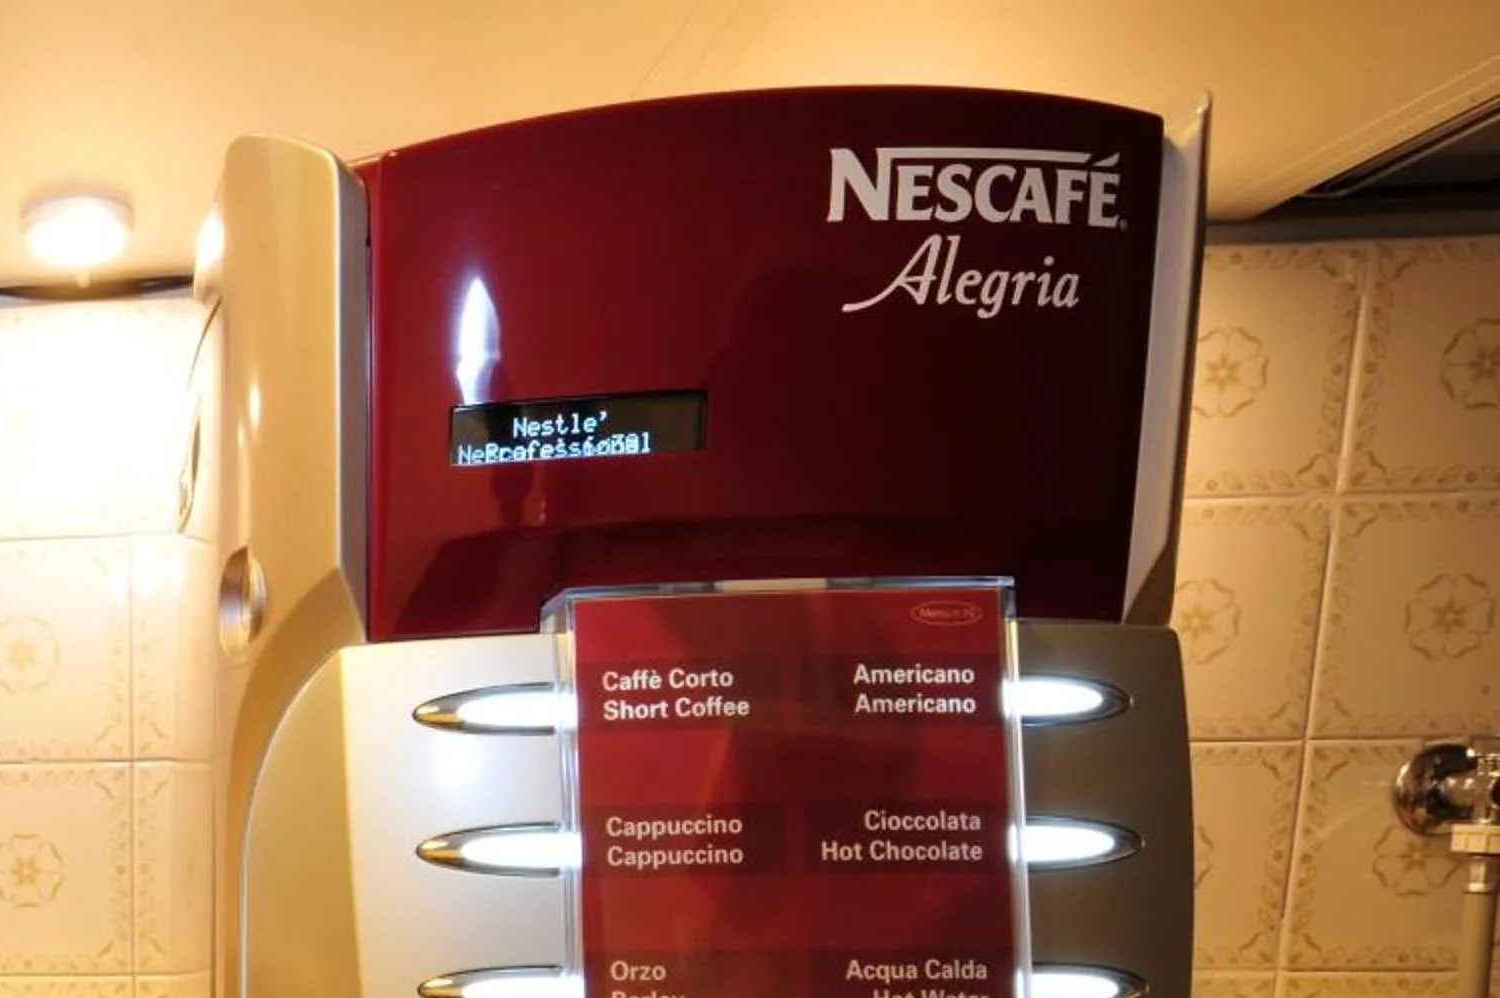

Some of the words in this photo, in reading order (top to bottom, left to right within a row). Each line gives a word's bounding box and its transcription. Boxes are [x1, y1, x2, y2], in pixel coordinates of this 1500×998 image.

[826, 147, 1122, 228] NESCAFÉ
[841, 233, 1081, 319] Alegria
[602, 668, 663, 691] Caffè
[668, 668, 734, 689] Corto
[853, 663, 975, 686] Americano
[603, 699, 669, 721] Short
[674, 696, 751, 719] Coffee
[854, 694, 977, 716] Americano
[605, 814, 744, 839] Cappuccino
[863, 809, 982, 832] Cioccolata
[606, 843, 744, 871] Cappuccino
[820, 841, 863, 862] Hot
[869, 839, 984, 862] Chocolate
[609, 960, 668, 983] Orzo
[845, 959, 919, 985] Acqua
[924, 958, 989, 981] Calda
